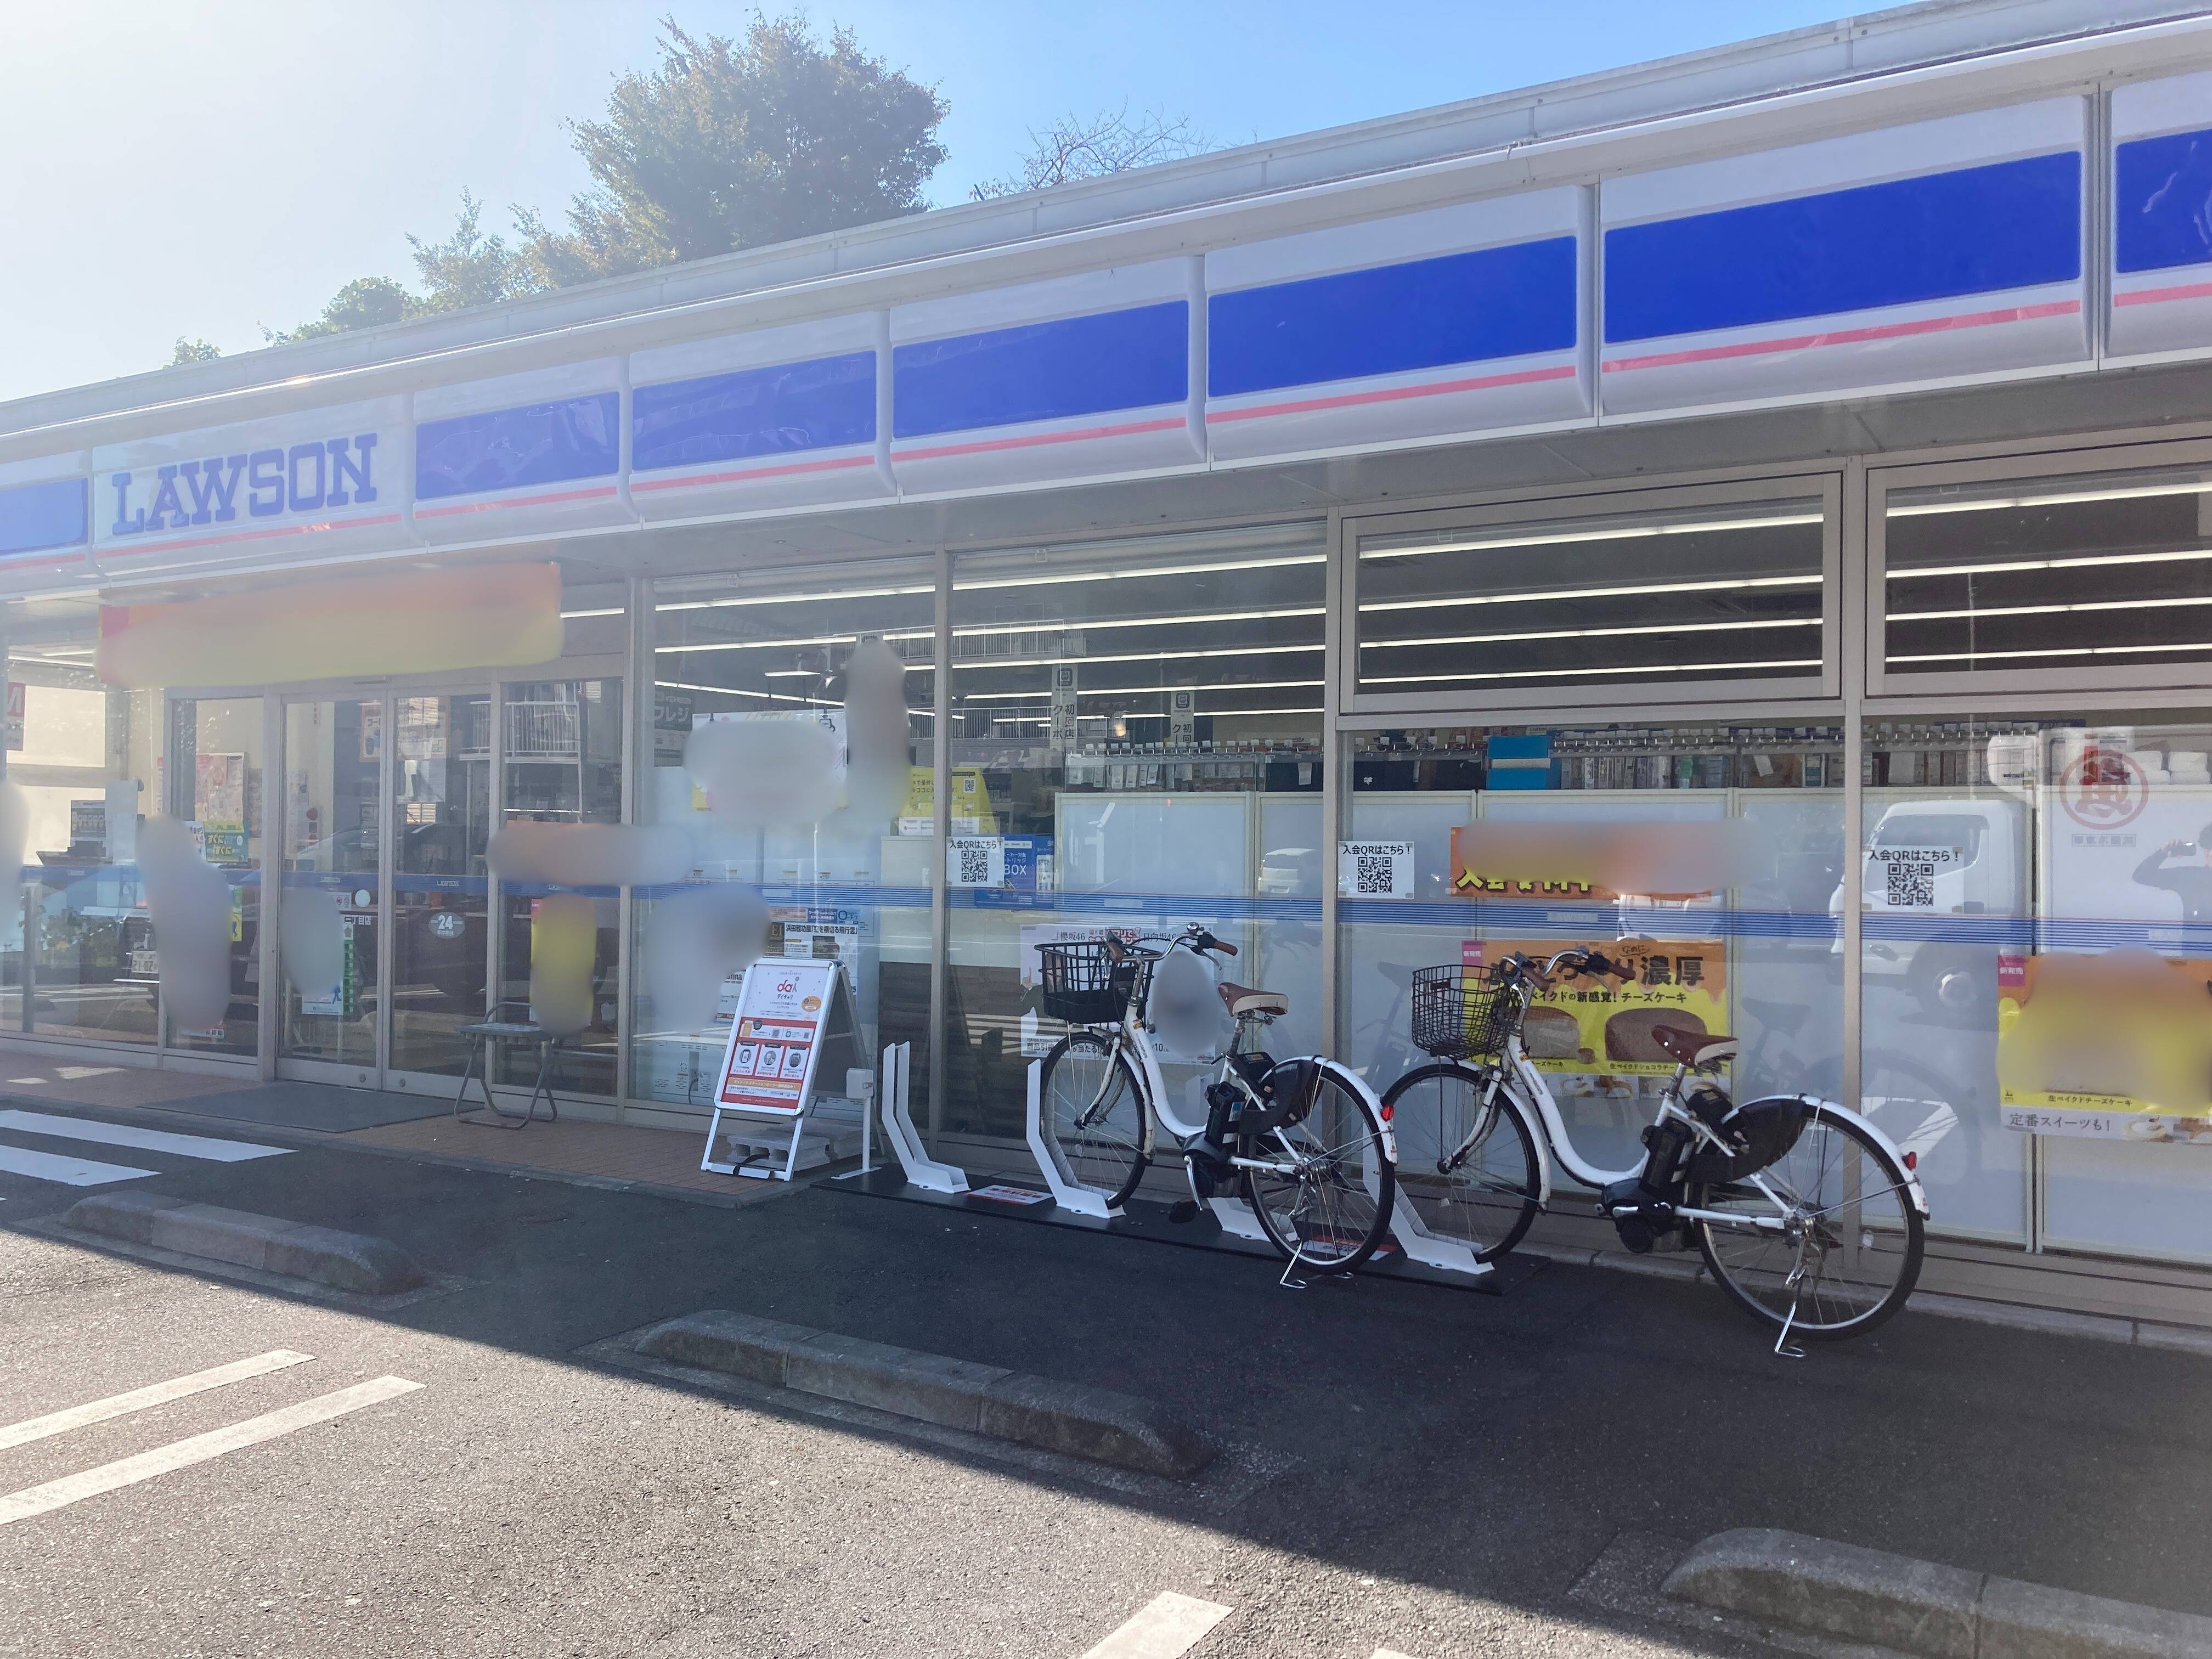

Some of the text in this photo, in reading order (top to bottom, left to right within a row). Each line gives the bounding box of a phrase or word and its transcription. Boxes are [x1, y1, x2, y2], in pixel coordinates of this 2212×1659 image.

[111, 432, 377, 536] LAWSON
[1342, 845, 1410, 856] 入会QRはこちら！
[438, 915, 453, 930] 24
